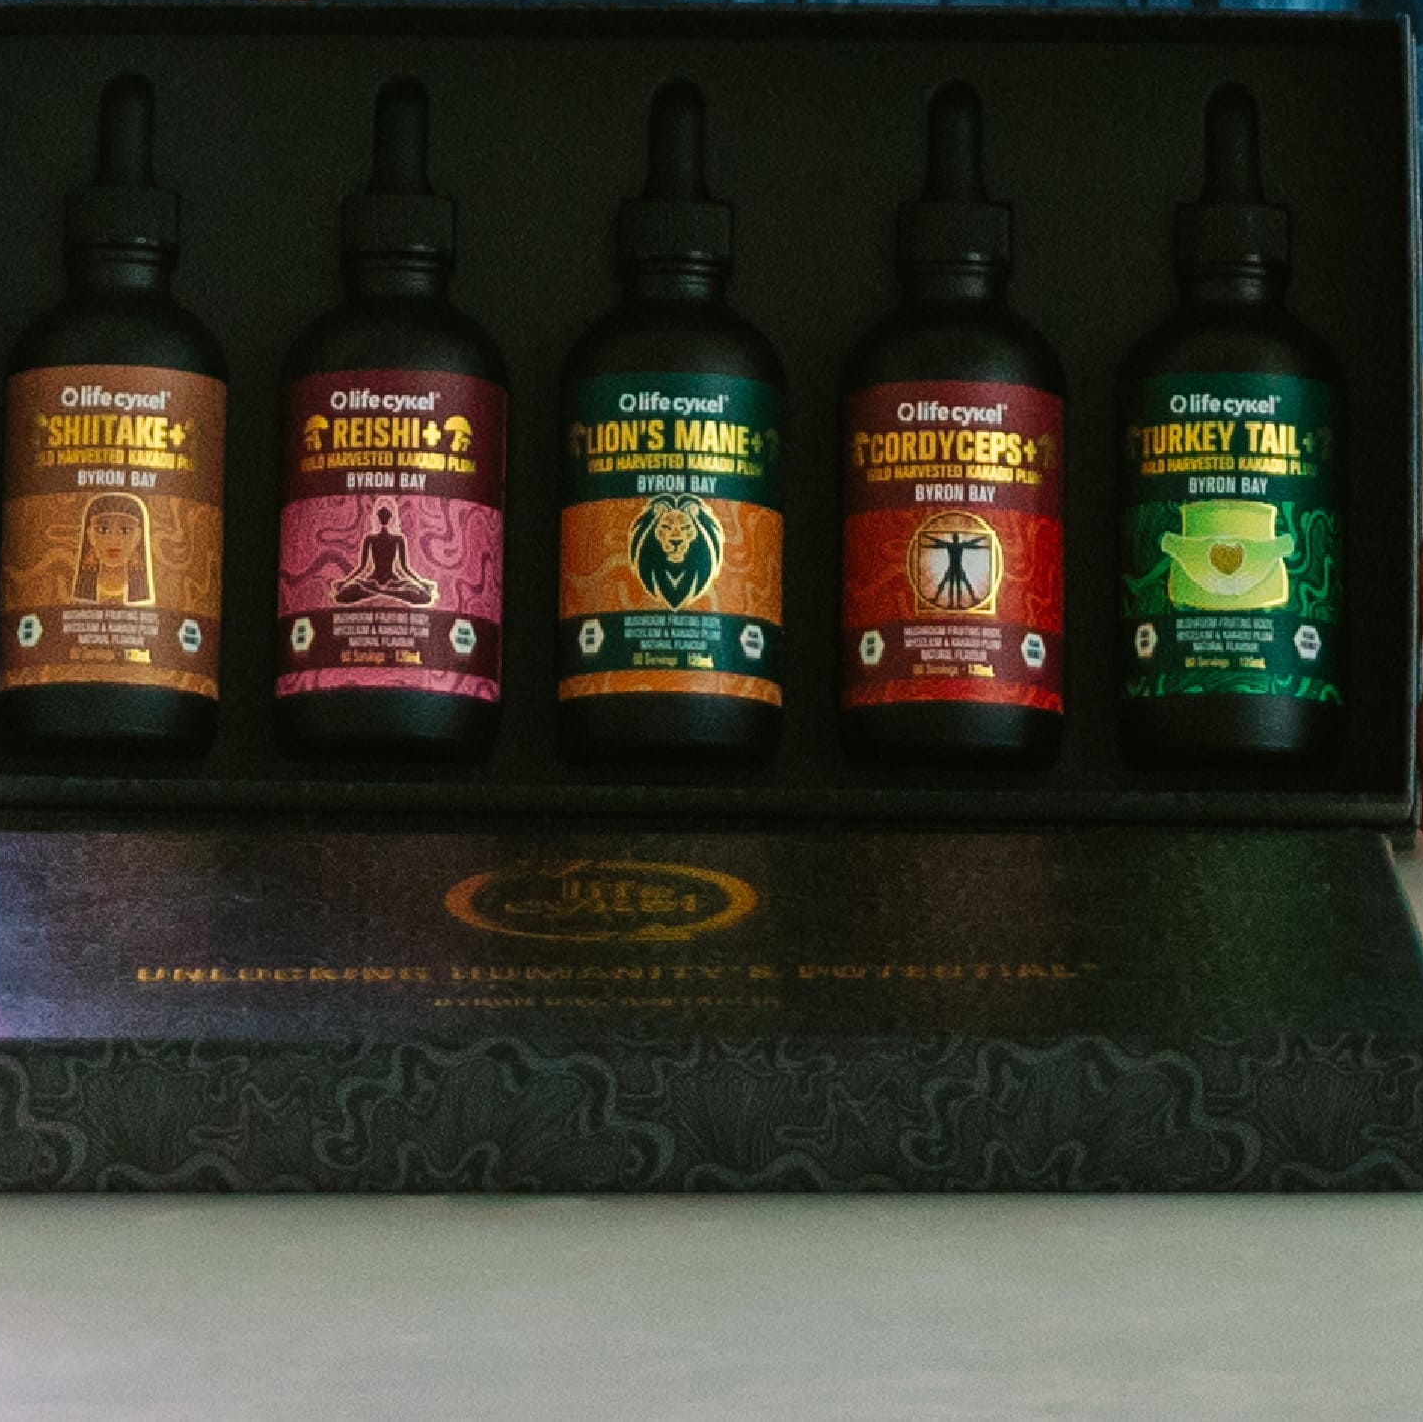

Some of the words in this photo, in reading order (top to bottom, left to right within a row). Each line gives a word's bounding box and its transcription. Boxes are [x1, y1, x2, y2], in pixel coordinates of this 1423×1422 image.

[81, 385, 112, 407] life
[114, 389, 166, 410] cykel
[349, 388, 379, 409] life
[383, 391, 435, 412] cykel
[638, 391, 670, 411] life
[673, 394, 723, 415] cykel
[1190, 394, 1220, 413] life
[1224, 395, 1275, 416] cykel
[917, 401, 948, 421] life
[953, 403, 1002, 427] cykel
[49, 415, 186, 449] SHIITAKE+
[333, 417, 442, 449] REISHI+
[586, 420, 665, 454] LION'S
[674, 420, 763, 455] MANE+
[1140, 421, 1235, 455] TURKEY
[1245, 422, 1313, 457] TAIL+
[870, 430, 1037, 466] CORDYCEPS+
[77, 469, 124, 486] BYRON
[131, 471, 157, 488] BAY
[346, 472, 394, 488] BYRON
[401, 473, 427, 490] BAY
[637, 475, 684, 492] BYRON
[689, 475, 717, 493] BAY
[1189, 477, 1236, 493] BYRON
[1241, 477, 1268, 494] BAY
[915, 483, 963, 502] BYRON
[968, 485, 996, 503] BAY
